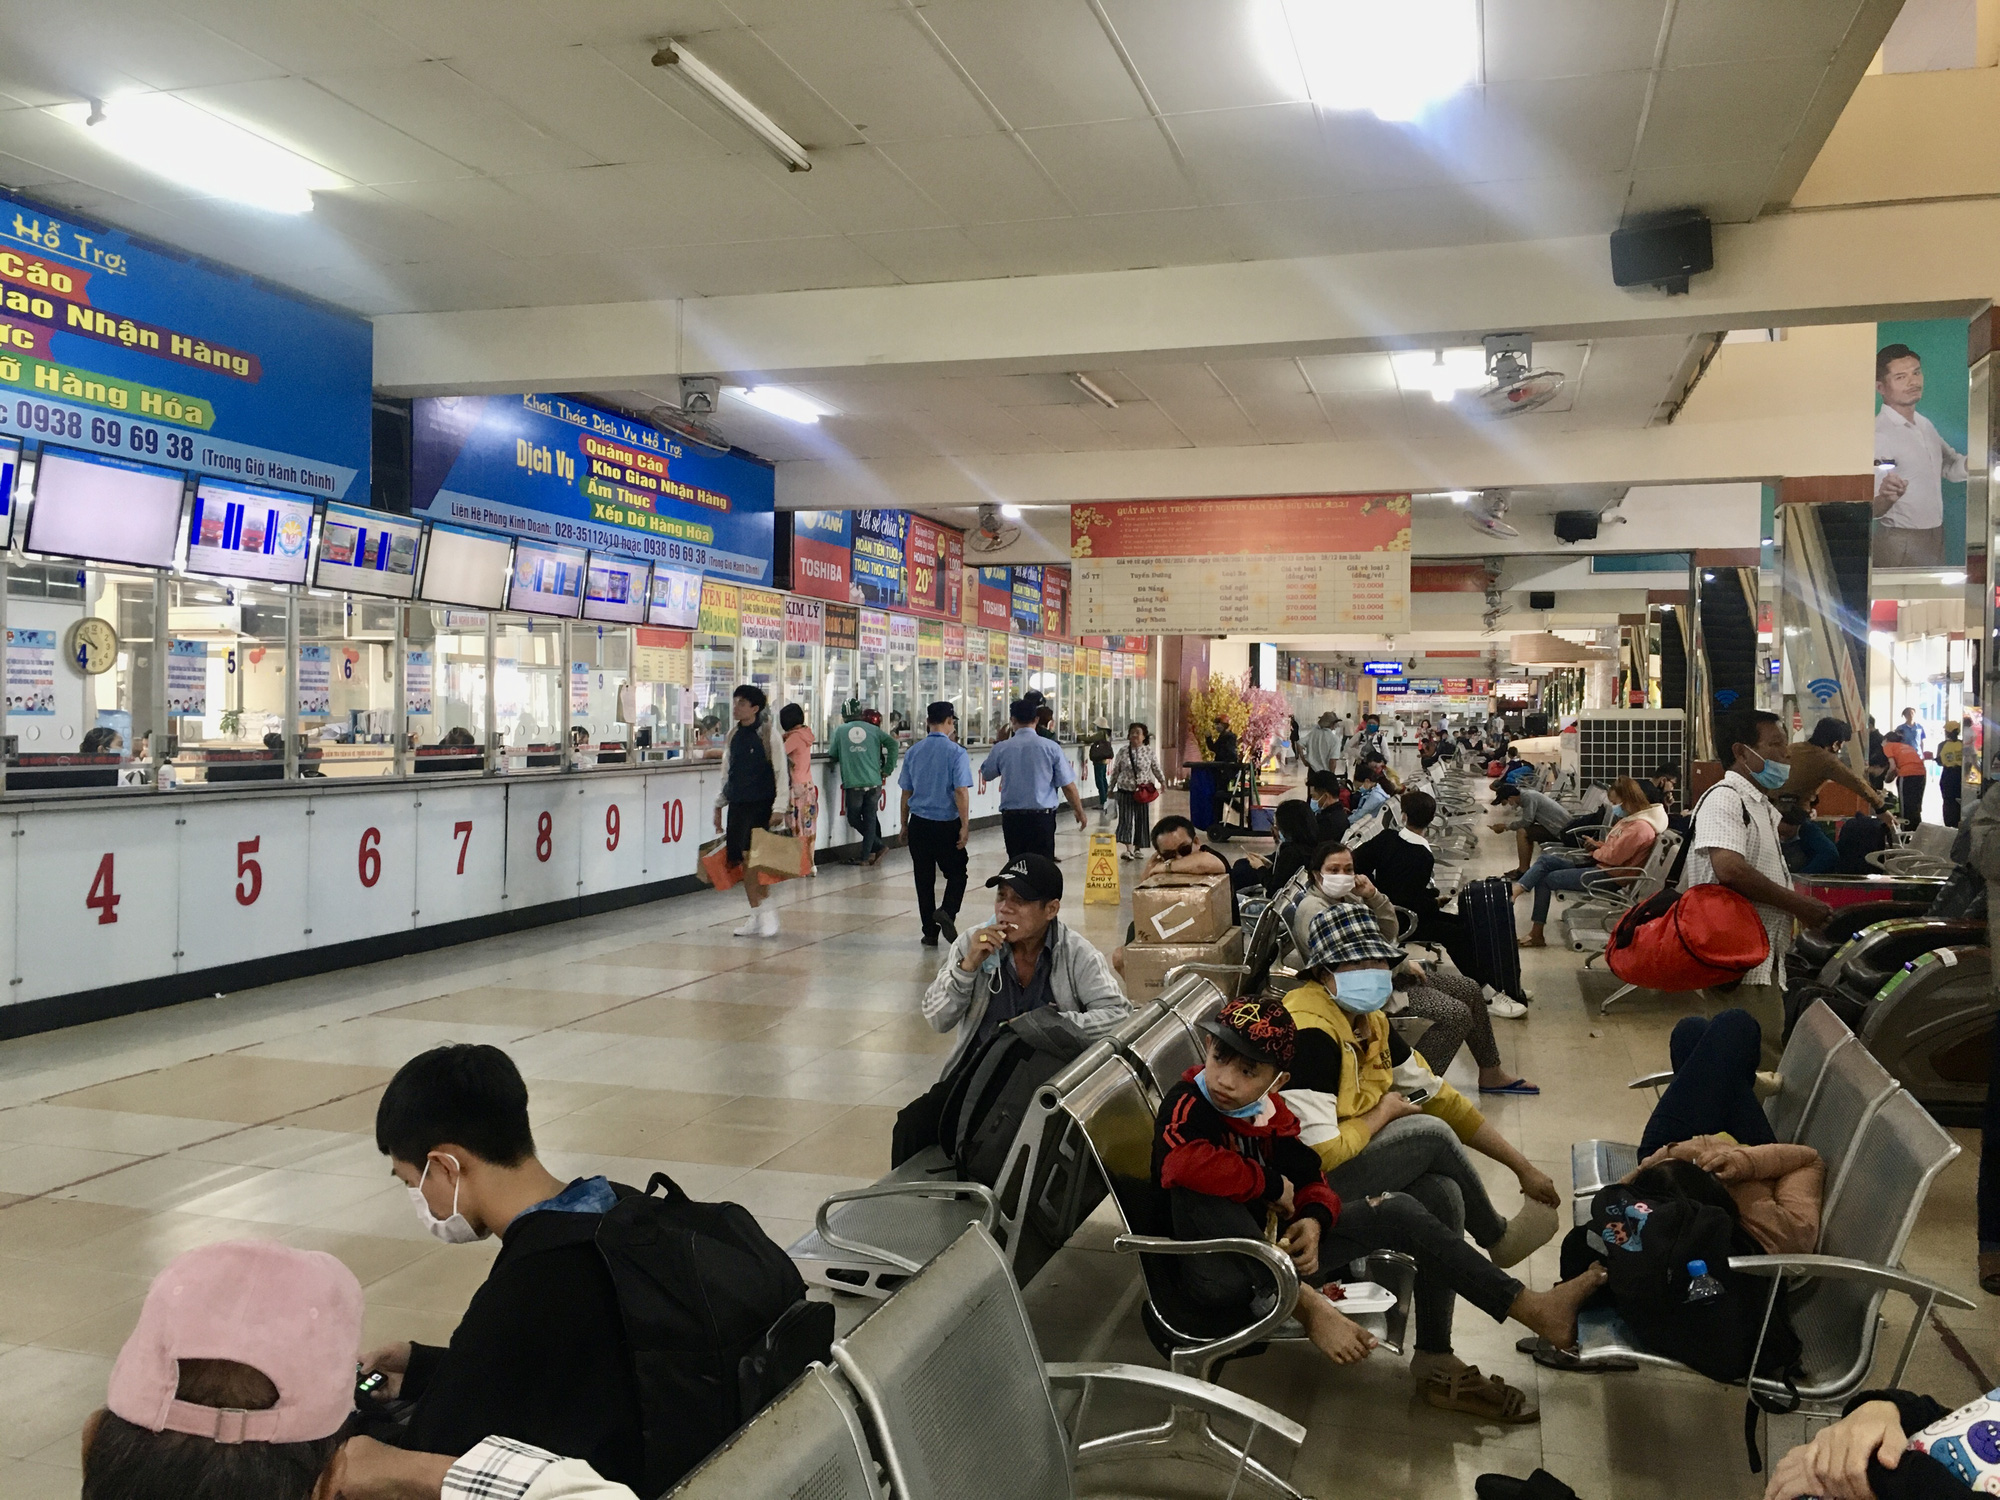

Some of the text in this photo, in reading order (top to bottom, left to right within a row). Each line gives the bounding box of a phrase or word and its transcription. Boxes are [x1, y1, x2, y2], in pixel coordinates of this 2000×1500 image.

[12, 213, 126, 275] Hỗ Trợ:
[0, 252, 72, 293] Cáo
[67, 303, 248, 376] Nhận Hàng
[35, 364, 203, 425] Hàng Hóa
[17, 400, 82, 440] 0938
[92, 417, 121, 448] 69
[130, 425, 158, 455] 69
[166, 432, 194, 463] 38
[202, 448, 242, 474] (Trong
[246, 457, 264, 476] Giờ
[269, 463, 297, 484] Hành
[523, 393, 683, 460] Khai Thác Dịch Vụ Hỗ Trợ:
[517, 438, 574, 486] Dịch Vụ
[586, 438, 664, 474] Quảng Cáo
[587, 475, 651, 509] Ẩm Thực
[592, 459, 727, 510] Kho Giao Nhận Hàng
[451, 502, 469, 518] Liên
[471, 507, 482, 524] Hệ
[484, 509, 507, 528] Phòng
[509, 515, 526, 530] Kinh
[528, 519, 552, 534] Doanh:
[555, 522, 619, 548] 028-35112410
[621, 536, 641, 553] hoặc
[644, 538, 666, 557] 0938
[670, 542, 680, 559] 69
[683, 545, 693, 562] 69
[696, 549, 706, 565] 38
[595, 503, 710, 543] Xếp Dỡ Hàng Hóa
[818, 512, 844, 534] XANH
[881, 514, 898, 538] chia
[800, 557, 843, 583] TOSHIBA
[855, 557, 870, 574] TRAO
[762, 595, 781, 605] LONG
[786, 600, 820, 619] KIM LÝ
[983, 600, 1007, 618] TOSHIBA
[528, 617, 533, 633] 8
[756, 616, 780, 627] KHÁNH
[76, 644, 89, 669] 4
[227, 651, 236, 674] 5
[344, 659, 352, 679] 6
[536, 811, 552, 862] 8
[606, 804, 620, 851] 9
[662, 799, 683, 843] 10
[358, 827, 381, 887] 6
[454, 820, 473, 874] 7
[86, 853, 121, 925] 4
[236, 835, 262, 906] 5
